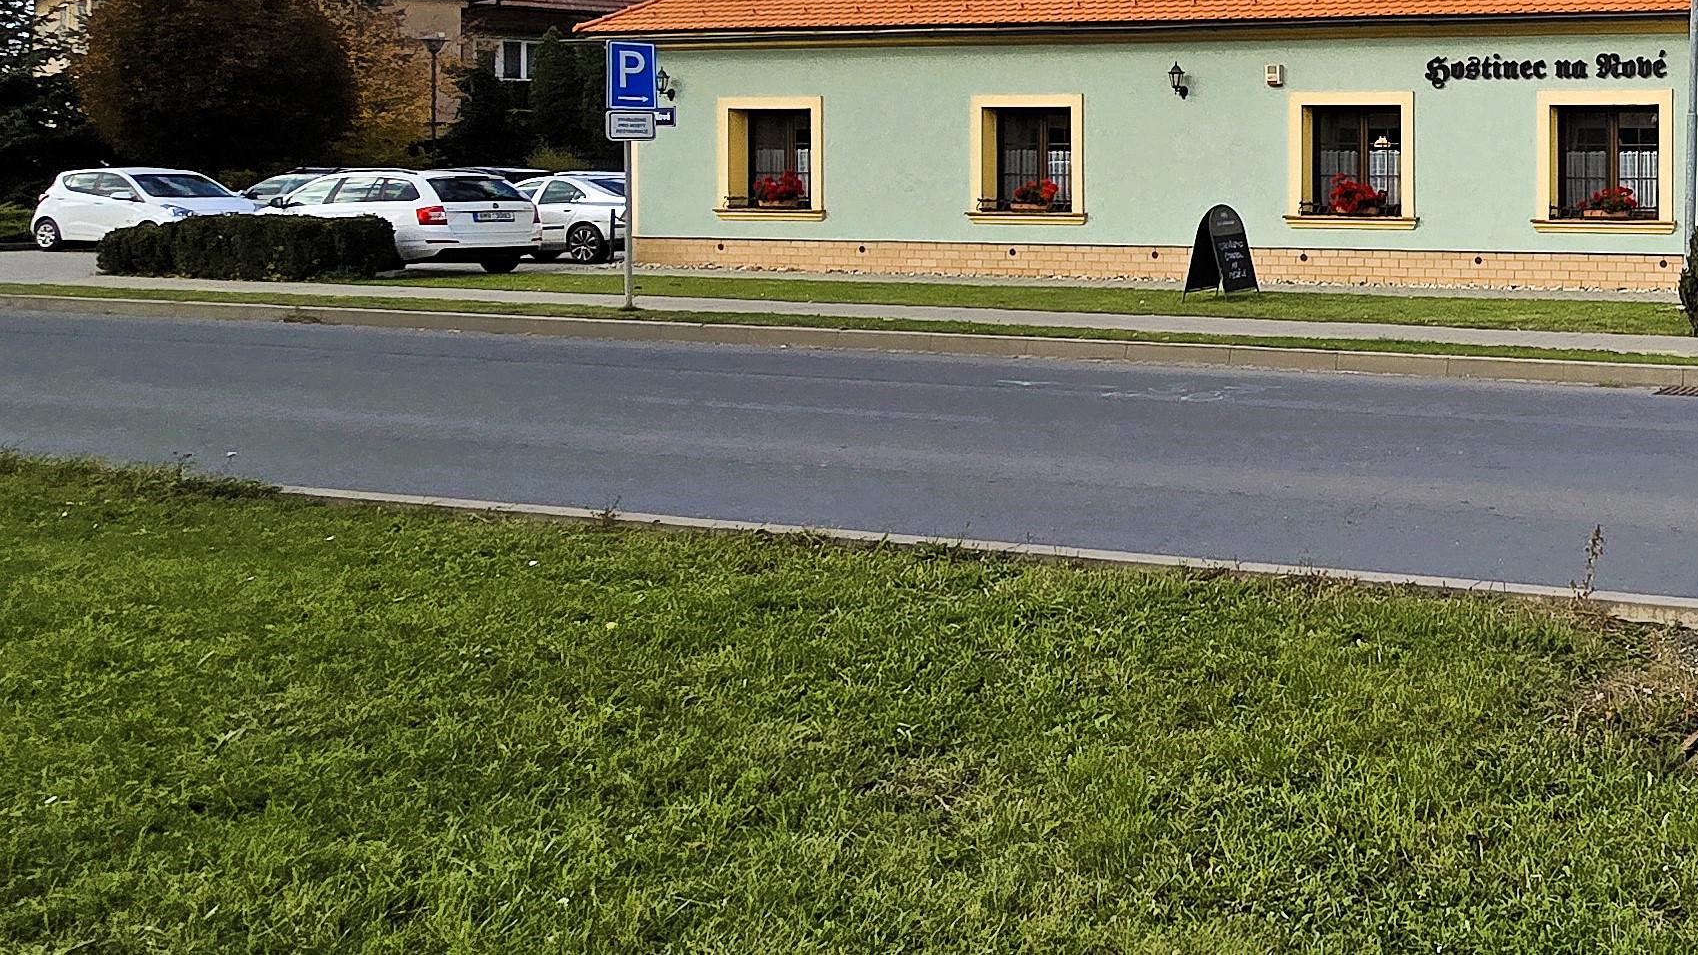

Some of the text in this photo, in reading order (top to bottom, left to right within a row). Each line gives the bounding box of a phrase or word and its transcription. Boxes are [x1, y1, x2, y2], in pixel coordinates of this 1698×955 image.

[618, 49, 646, 89] P
[1424, 49, 1668, 90] Hostinec na Nové
